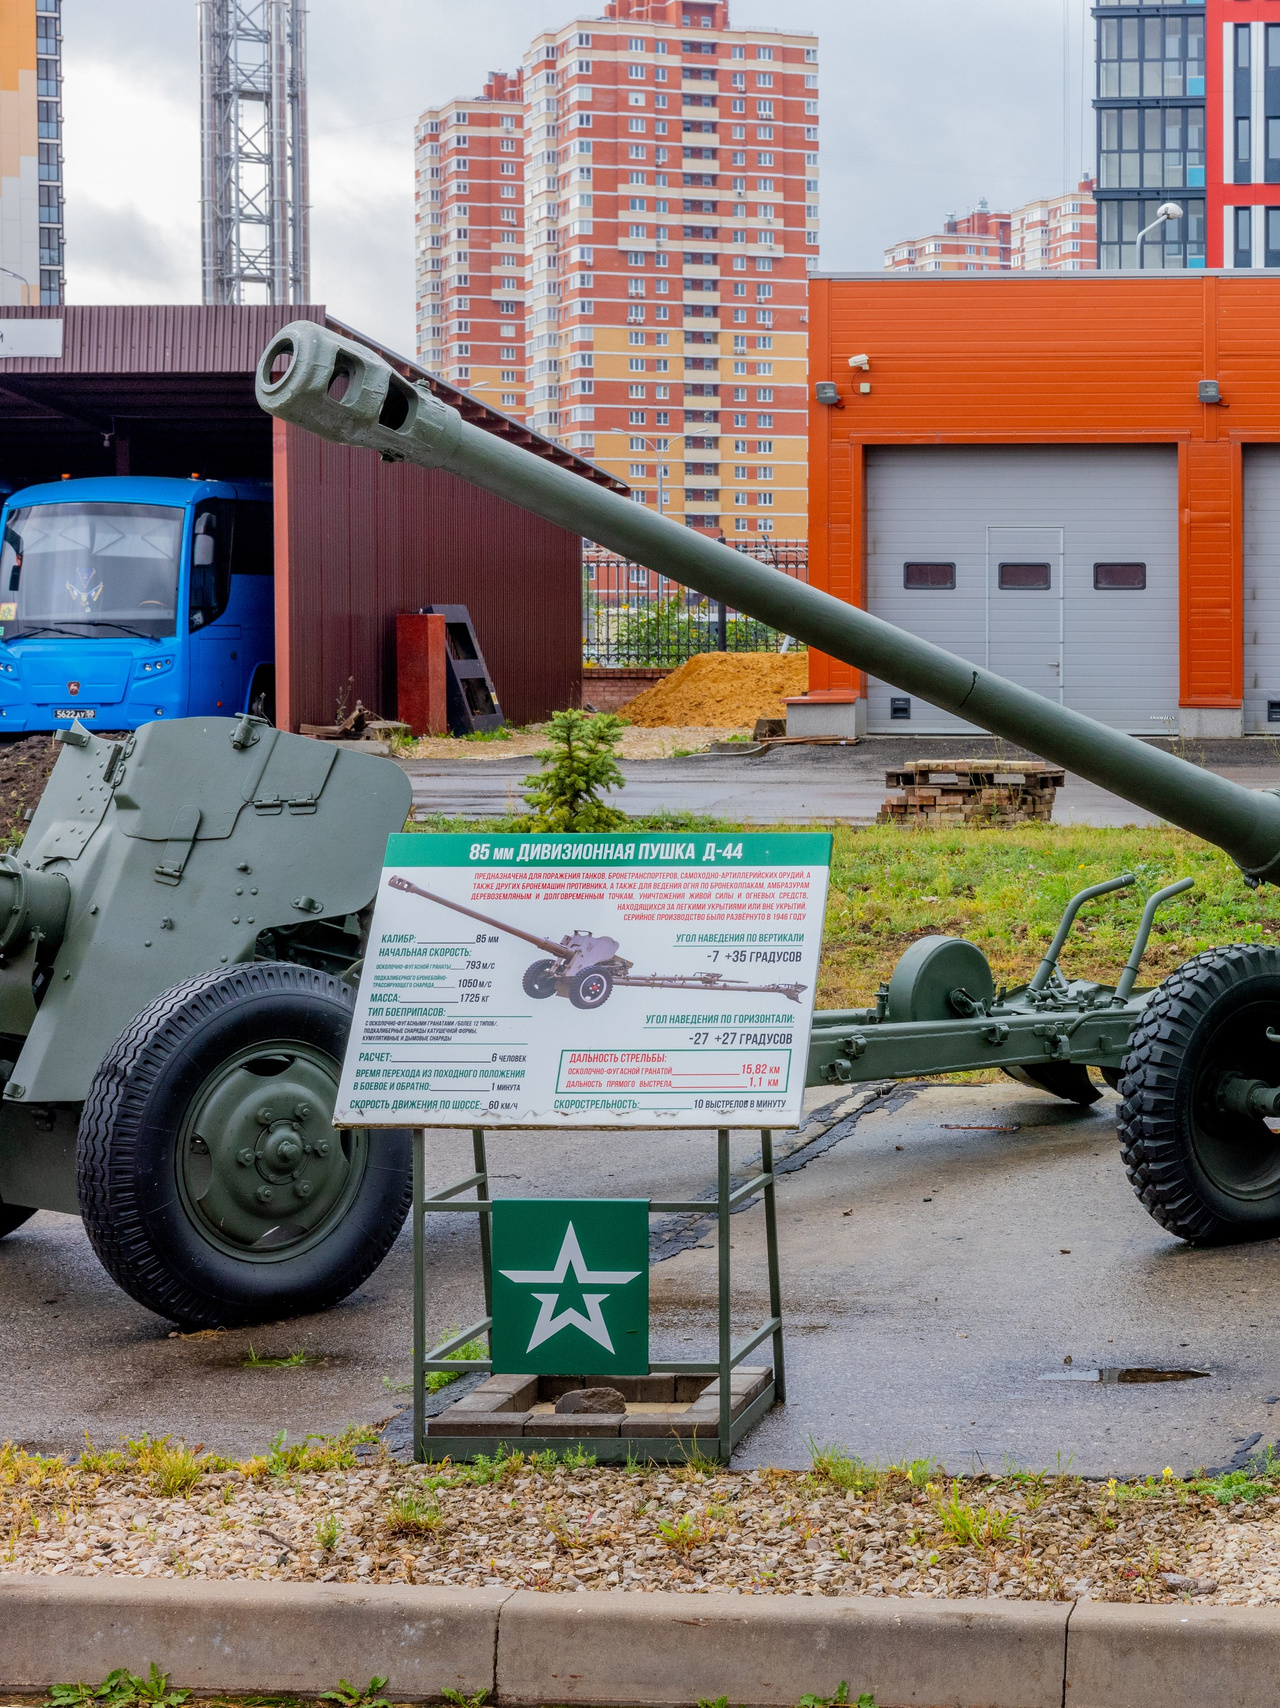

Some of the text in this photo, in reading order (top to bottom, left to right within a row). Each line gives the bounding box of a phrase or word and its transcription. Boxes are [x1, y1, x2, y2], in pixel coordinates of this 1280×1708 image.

[469, 843, 491, 860] 85
[516, 843, 636, 862] ДИВИЗИОННАЯ
[638, 843, 696, 860] ПУШКА
[702, 842, 743, 862] Д-44
[617, 903, 666, 911] НАХОДЯЩИХСЯ
[666, 903, 675, 911] ЗА
[675, 903, 707, 911] ЛЕГКИМИ
[707, 903, 747, 911] УКРЫТИЯМИ
[623, 912, 656, 921] СЕРИЙНОЕ
[656, 913, 706, 921] ПРОИЗВОДСТВО
[706, 913, 726, 921] БЫЛО
[766, 913, 771, 921] В
[773, 913, 789, 921] 1946
[789, 913, 807, 921] ГОДУ
[381, 934, 417, 943] КАЛИБР:
[475, 934, 487, 943] 85
[676, 933, 805, 943] УГОЛ НАВЕДЕНИЯ ПО ВЕРТИКАЛИ
[378, 947, 473, 957] НАЧАЛЬНАЯ СКОРОСТЬ:
[707, 950, 802, 964] -7 +35 ГРАДУСОВ
[466, 960, 482, 970] 793
[458, 978, 479, 988] 1050
[370, 993, 402, 1003] МАССА:
[460, 993, 481, 1003] 1725
[368, 1007, 447, 1017] ТИП БОЕПРИПАСОВ:
[646, 1014, 796, 1025] УГОЛ НАВЕДЕНИЯ ПО ГОРИЗОНТАЛИ:
[689, 1032, 793, 1046] -27 +27 ГРАДУСОВ
[358, 1052, 393, 1062] РАСЧЕТ:
[491, 1052, 498, 1062] 6
[569, 1053, 668, 1064] ДАЛЬНОСТЬ СТРЕЛЬБЫ:
[355, 1069, 526, 1079] ВРЕМЯ ПЕРЕХОДА ИЗ ПОХОДНОГО ПОЛОЖЕНИЯ
[567, 1066, 641, 1075] ОСКОЛОЧНО-ФУГАСНОЙ
[641, 1066, 673, 1075] ГРАНАТОЙ
[742, 1063, 768, 1075] 15,82
[353, 1082, 359, 1091] В
[359, 1081, 388, 1091] БОЕВОЕ
[389, 1082, 395, 1091] И
[395, 1082, 432, 1091] ОБРАТНО:
[491, 1082, 495, 1091] 1
[565, 1080, 603, 1089] ДАЛЬНОСТЬ
[606, 1080, 636, 1088] ПРЯМОГО
[639, 1080, 672, 1088] ВЫСТРЕЛА
[349, 1099, 390, 1110] СКОРОСТЬ
[391, 1099, 438, 1110] ДВИЖЕНИЯ
[439, 1100, 451, 1110] ПО
[452, 1100, 483, 1110] ШОССЕ:
[488, 1100, 500, 1110] 60
[553, 1099, 641, 1109] СКОРОСТРЕЛЬНОСТЬ:
[694, 1099, 704, 1109] 10
